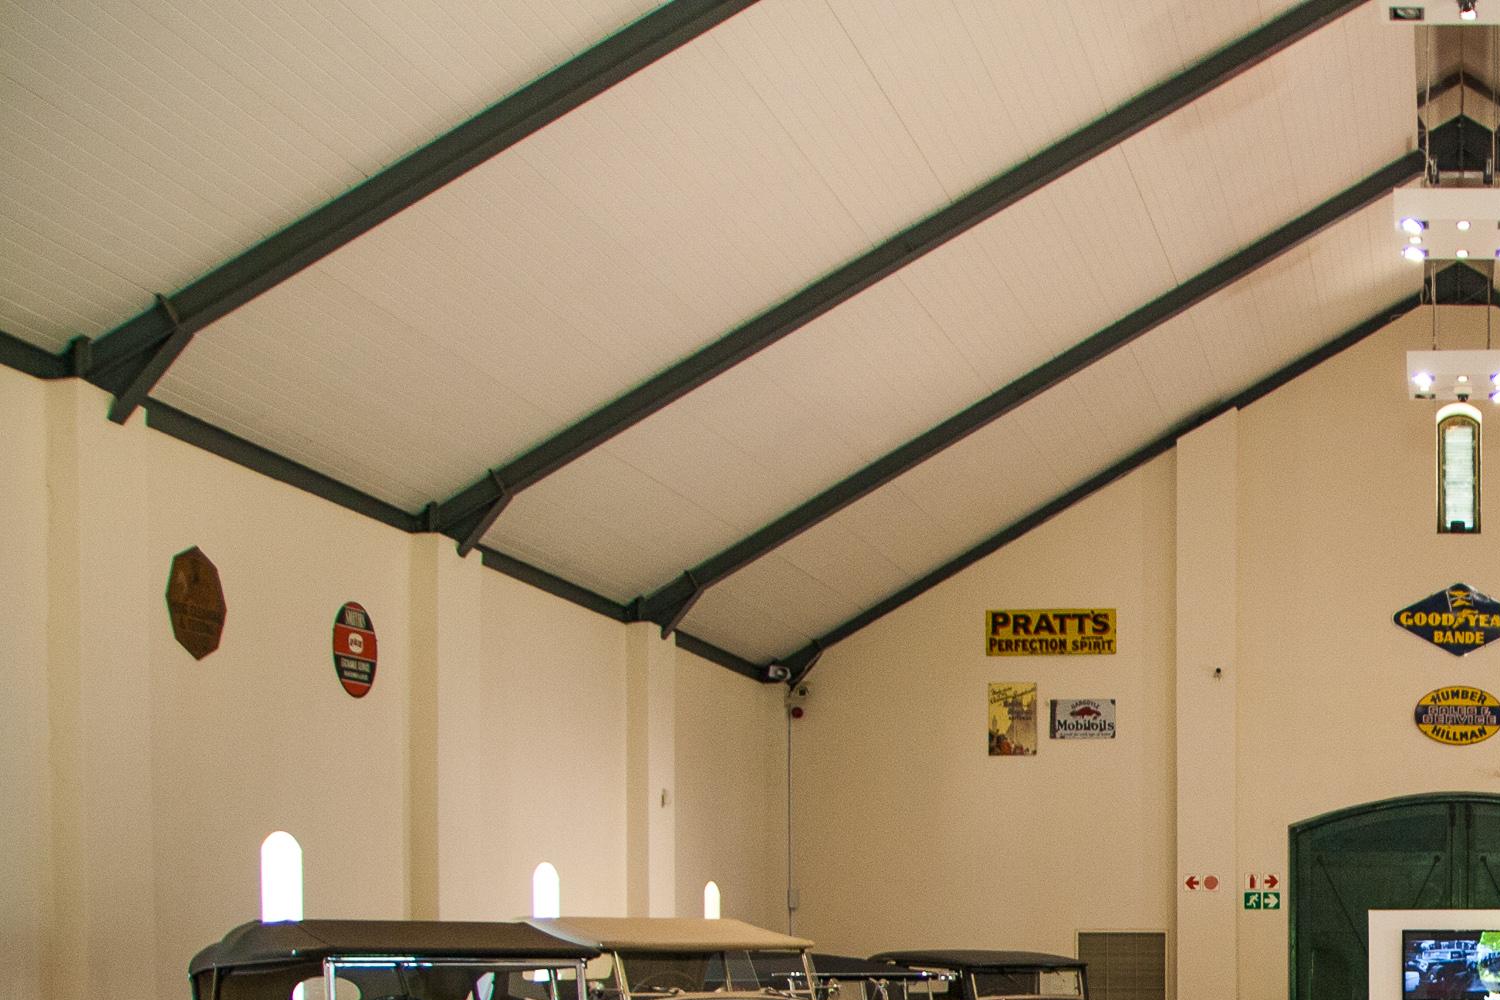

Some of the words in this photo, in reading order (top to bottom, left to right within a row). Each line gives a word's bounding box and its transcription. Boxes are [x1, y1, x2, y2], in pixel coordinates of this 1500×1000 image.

[991, 610, 1110, 636] PRATT'S
[989, 637, 1067, 652] PERFECTION
[1072, 639, 1114, 651] SPIRIT
[1433, 630, 1485, 645] BANDE
[1430, 689, 1487, 704] HUMBER
[1056, 719, 1115, 732] Mobiloils
[1431, 725, 1487, 741] HILLMAN
